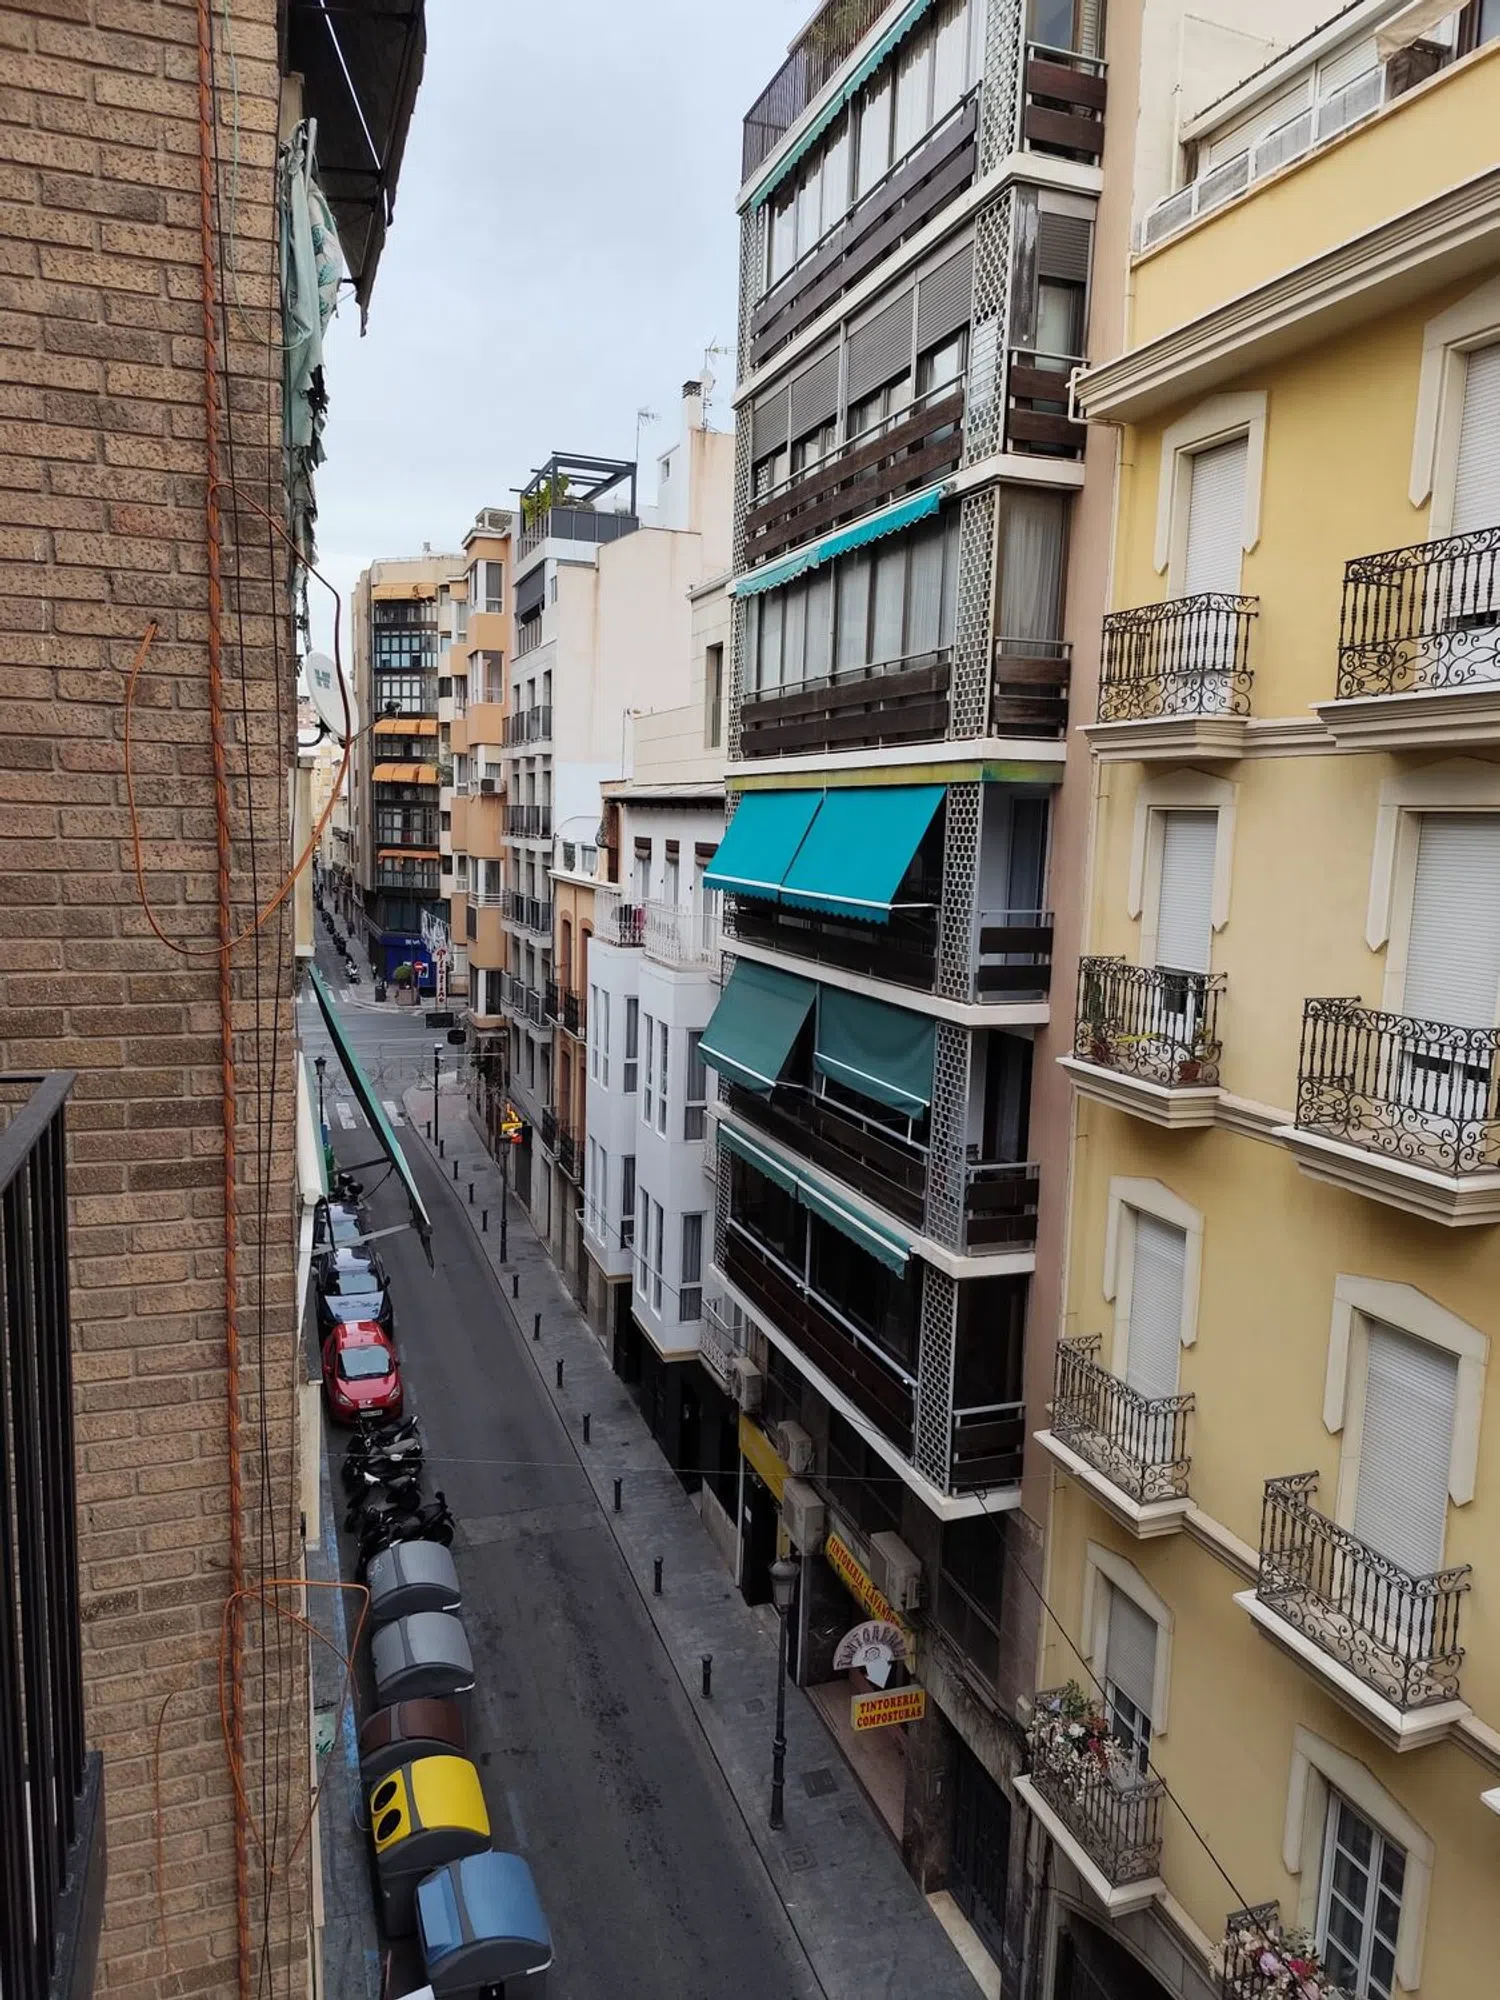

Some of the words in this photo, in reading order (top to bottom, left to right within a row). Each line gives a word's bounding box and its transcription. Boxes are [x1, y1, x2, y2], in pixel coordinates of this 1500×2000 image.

[829, 1536, 865, 1589] TINTORERIA
[837, 1625, 907, 1665] TINTORERIA
[856, 1705, 922, 1727] COMPOSTURAS
[860, 1693, 921, 1713] TINTORERIA
